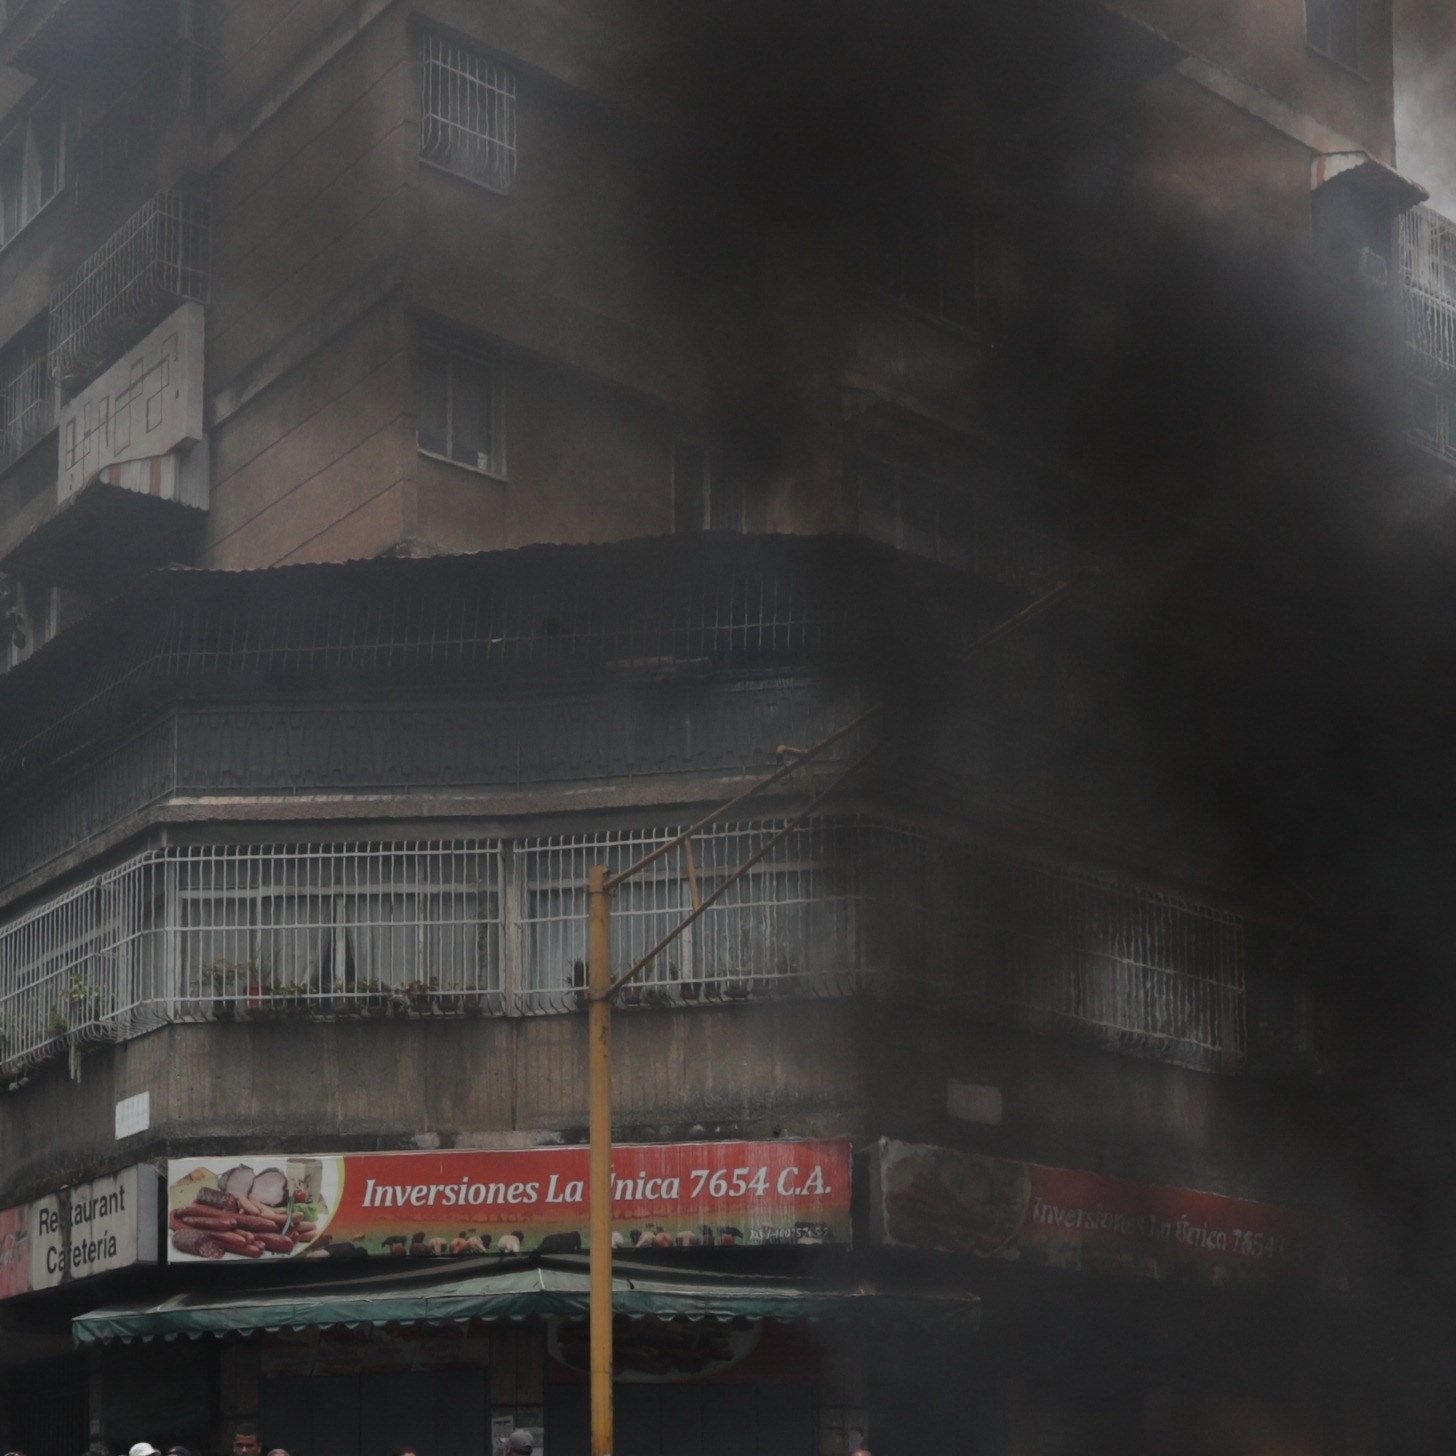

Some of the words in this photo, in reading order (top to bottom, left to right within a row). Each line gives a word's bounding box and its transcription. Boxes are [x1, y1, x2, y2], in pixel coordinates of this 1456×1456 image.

[362, 1176, 540, 1207] Inversiones
[545, 1174, 585, 1204] La
[690, 1166, 769, 1199] 7654
[776, 1164, 832, 1196] C.A.
